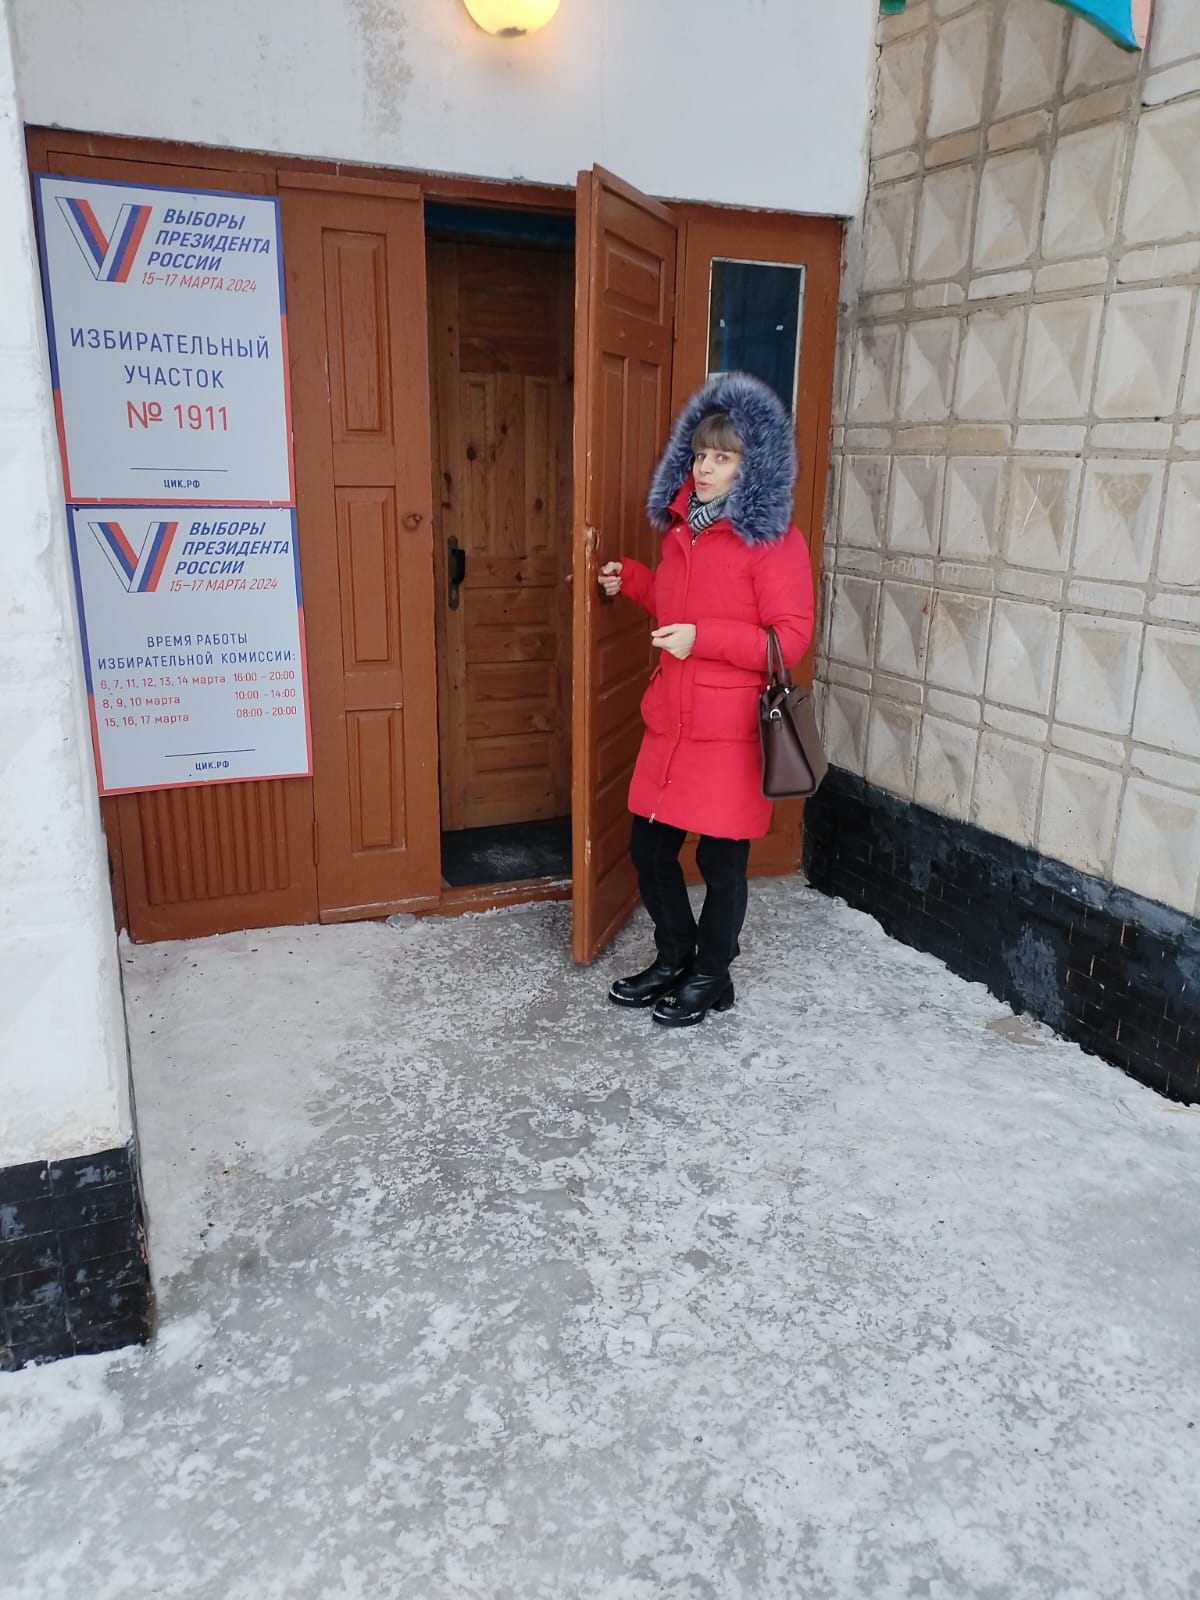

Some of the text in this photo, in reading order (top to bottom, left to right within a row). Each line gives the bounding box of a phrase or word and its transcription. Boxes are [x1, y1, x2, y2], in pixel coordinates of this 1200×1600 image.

[163, 208, 246, 230] ВЫБОРЫ
[155, 230, 271, 254] ПРЕЗИДЕНТА
[147, 251, 223, 272] РОССИИ
[179, 274, 223, 291] МАРТА
[226, 278, 257, 293] 2024
[70, 327, 269, 359] ИЗБИРАТЕЛЬНЫЙ
[124, 365, 224, 389] УЧАСТОК
[126, 401, 228, 431] № 1911
[163, 479, 201, 489] ЦИК.РФ
[189, 521, 266, 536] ВЫБОРЫ
[182, 541, 290, 557] ПРЕЗИДЕНТА
[175, 560, 245, 575] РОССИИ
[205, 578, 246, 591] МАРТА
[249, 577, 278, 590] 2024
[147, 633, 248, 648] ВРЕМЯ РАБОТЫ
[98, 650, 296, 670] ИЗБИРАТЕЛЬНОЙ КОМИССИИ:
[177, 676, 188, 685] 14
[192, 674, 226, 686] марта
[269, 670, 295, 681] 20:00
[116, 697, 127, 708] 9,
[130, 697, 142, 707] 10
[145, 696, 180, 707] марта
[235, 690, 259, 700] 10:00
[271, 688, 296, 698] 14:00
[105, 717, 119, 728] 15,
[141, 715, 151, 725] 17
[155, 714, 189, 725] марта
[236, 708, 263, 718] 08:00
[272, 705, 297, 716] 20:00
[195, 760, 230, 771] ЦИК.РФ
